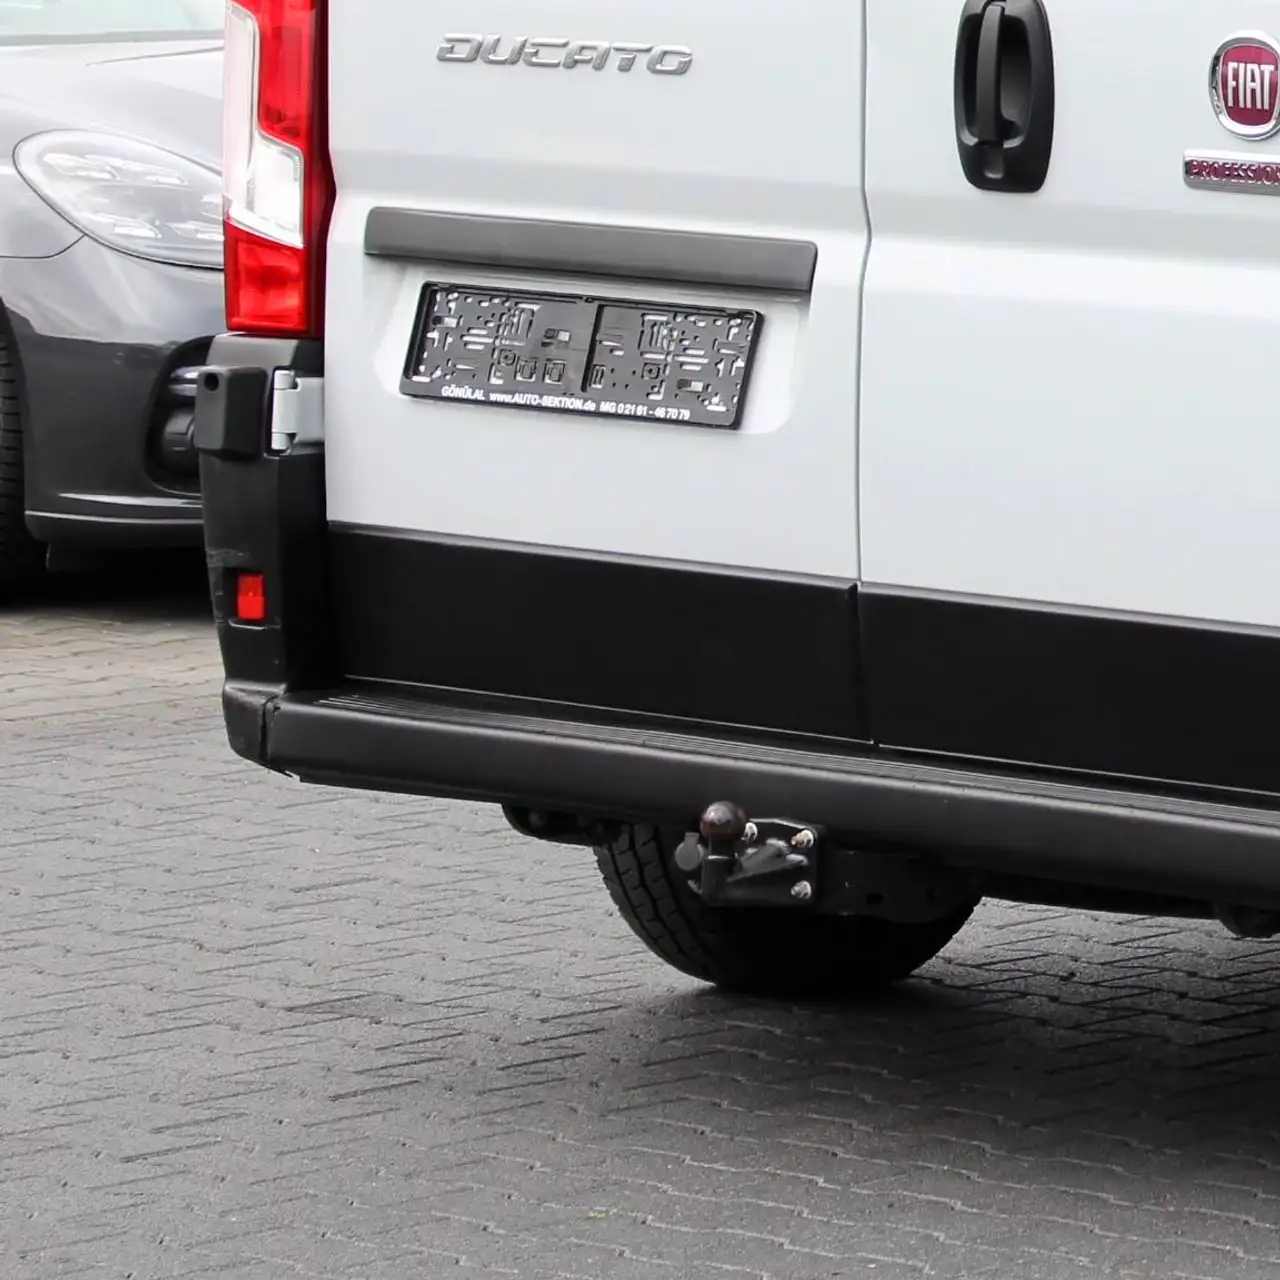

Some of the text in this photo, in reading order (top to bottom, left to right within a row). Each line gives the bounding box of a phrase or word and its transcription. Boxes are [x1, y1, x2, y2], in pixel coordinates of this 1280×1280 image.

[436, 32, 693, 75] DUCATO
[1227, 61, 1276, 110] FIAT
[441, 384, 486, 400] GÖNÜLAL
